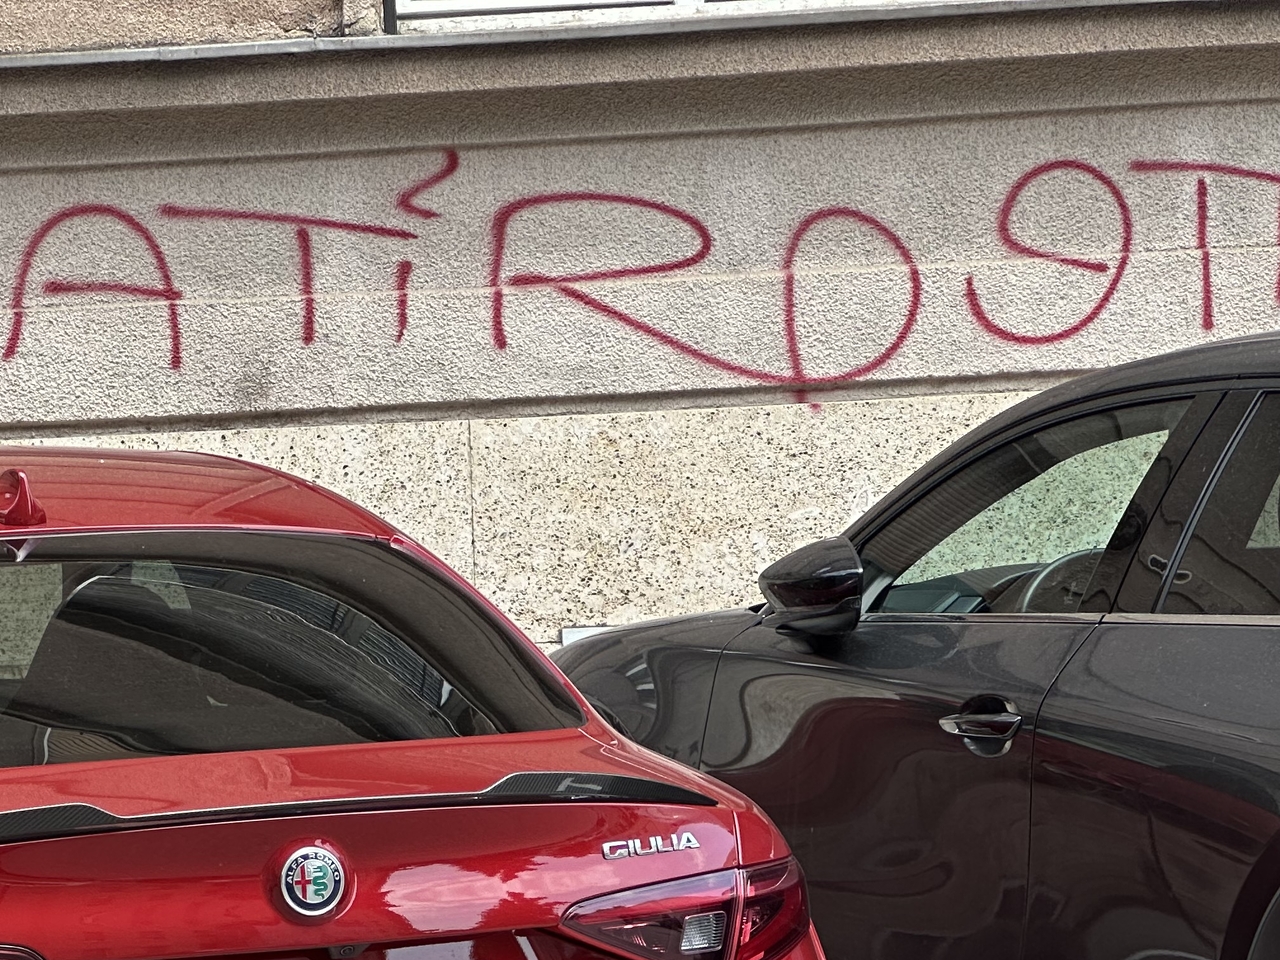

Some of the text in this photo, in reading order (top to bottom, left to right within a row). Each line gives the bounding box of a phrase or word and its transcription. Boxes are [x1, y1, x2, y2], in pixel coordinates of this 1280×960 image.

[602, 831, 700, 860] GIULIA
[287, 852, 340, 884] ALFA ROMEO
